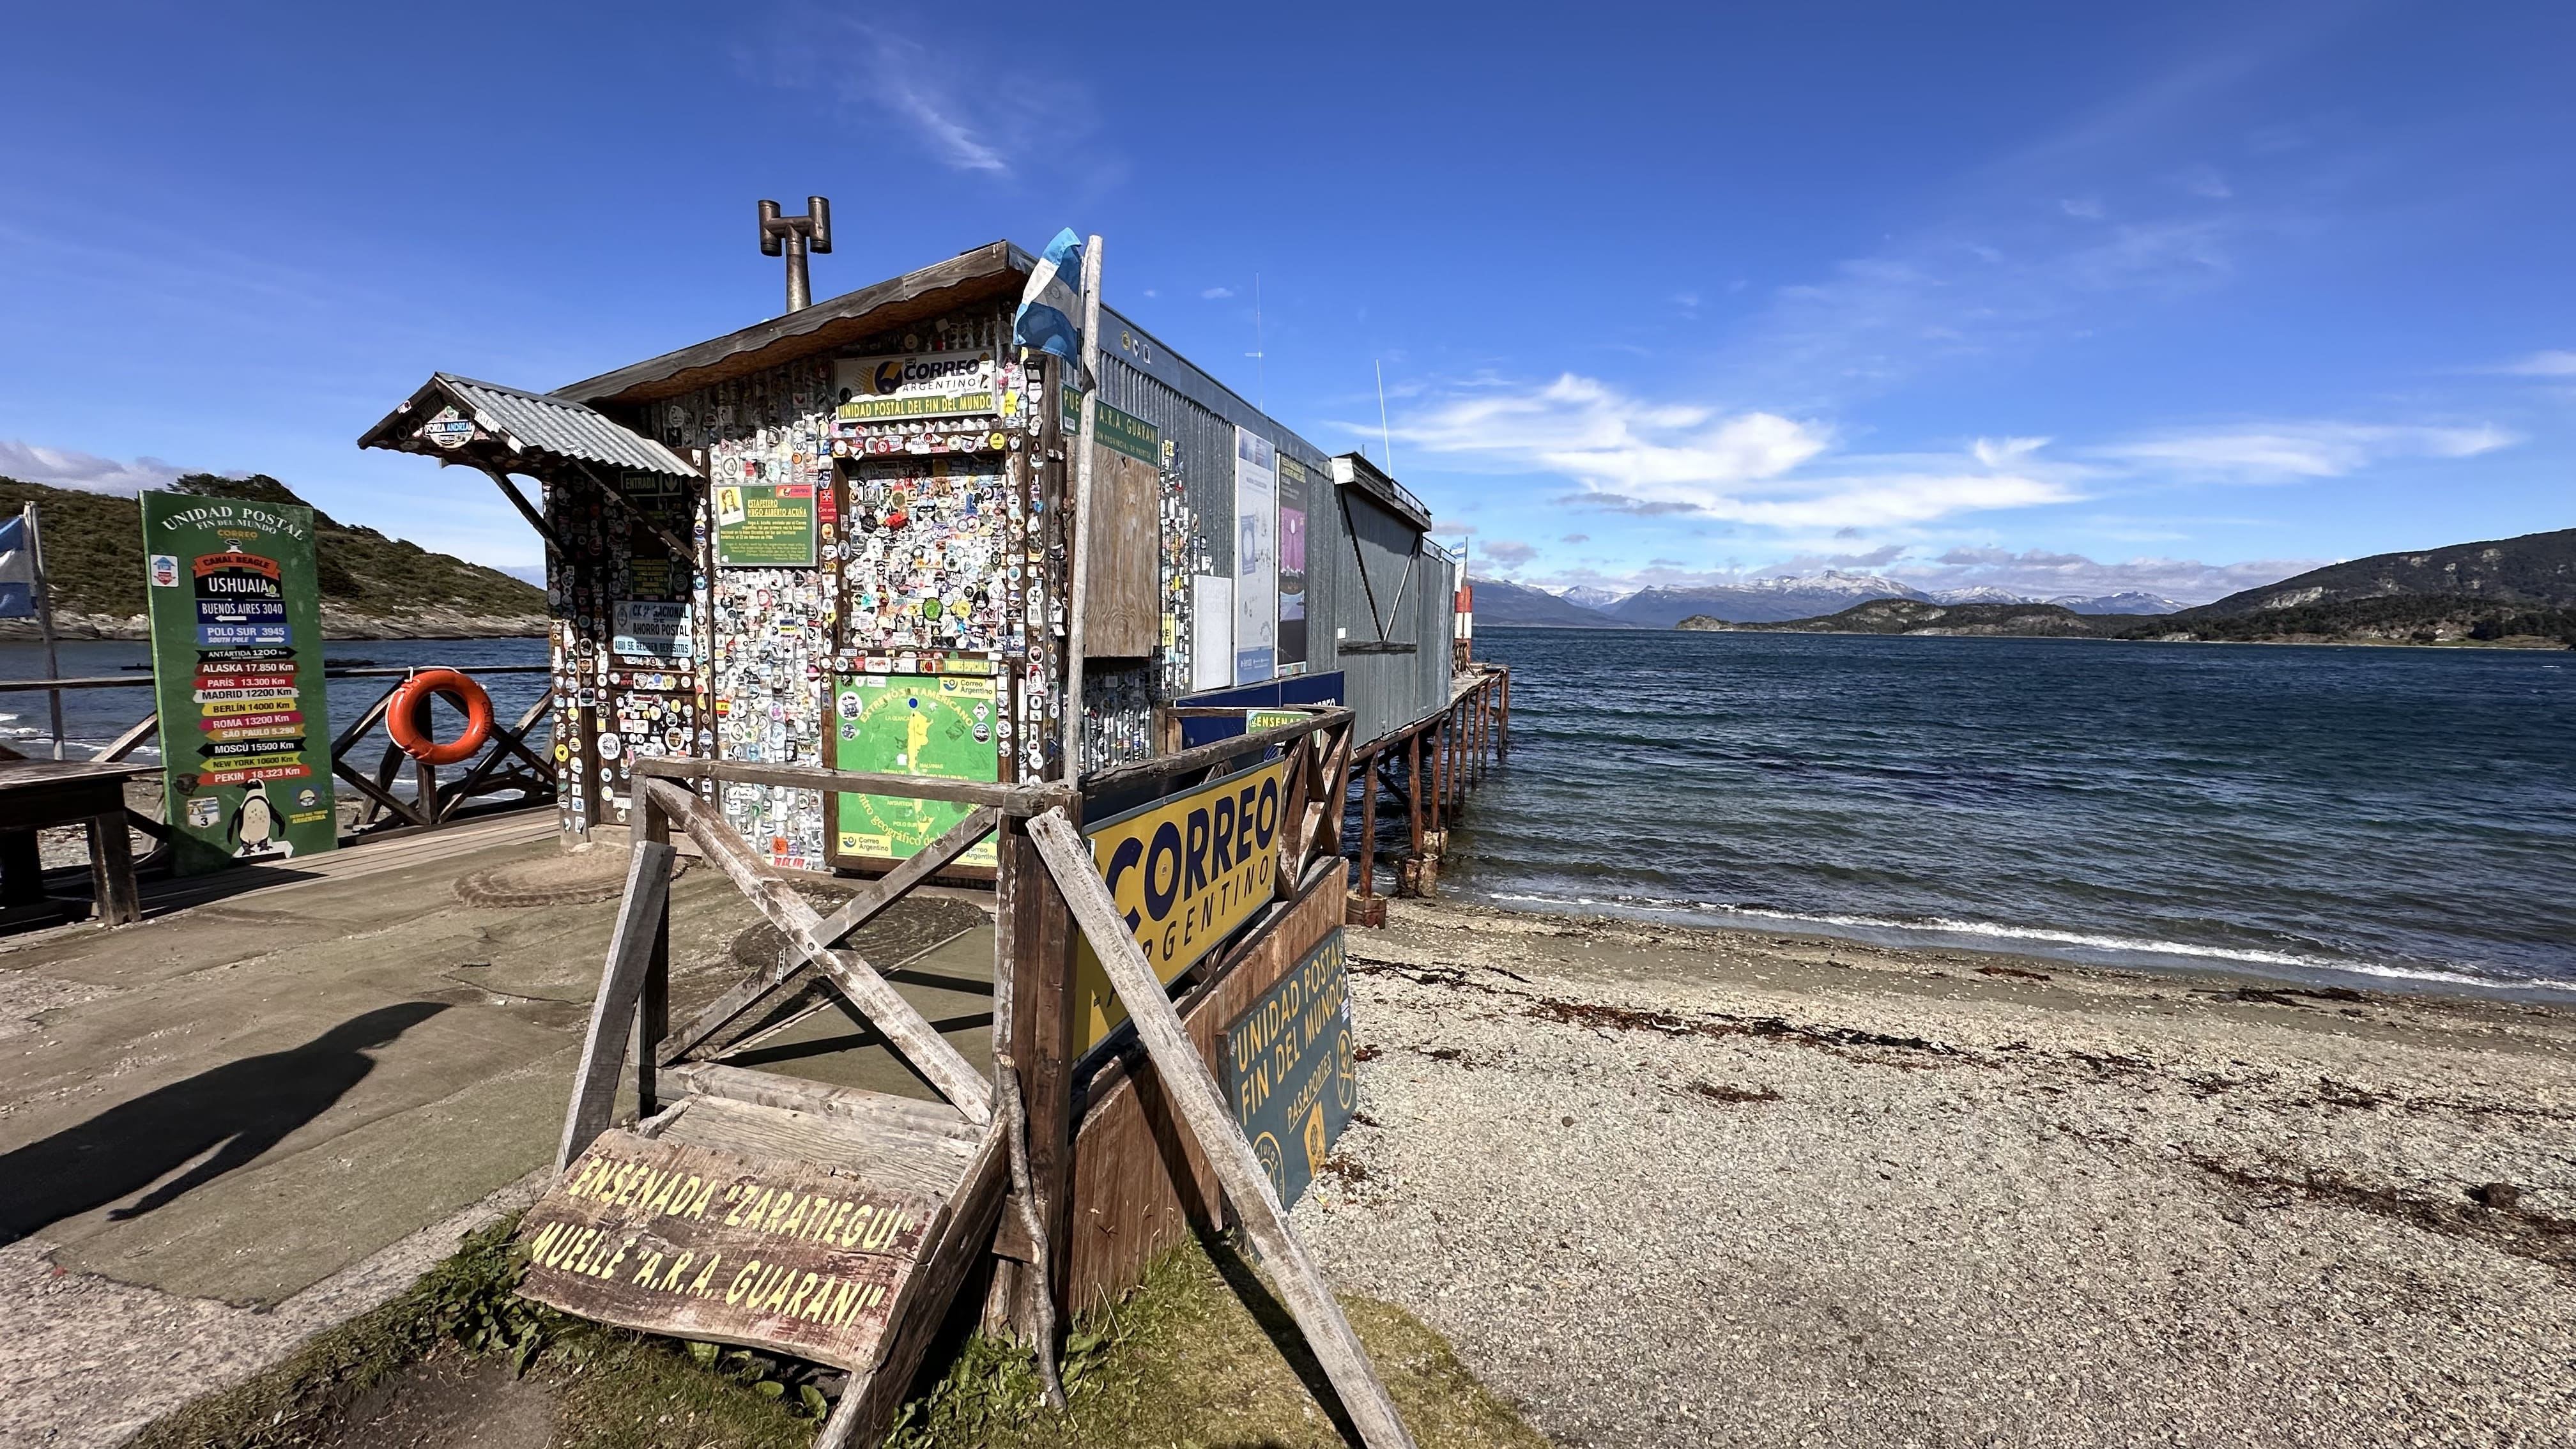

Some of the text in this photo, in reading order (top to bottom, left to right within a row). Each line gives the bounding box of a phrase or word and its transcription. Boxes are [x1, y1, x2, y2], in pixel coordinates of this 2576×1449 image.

[904, 358, 979, 380] CORREO
[903, 378, 976, 392] ARGENTINO
[840, 395, 992, 418] UNIDAD POSTAL DEL FIN DEL MUNDO
[1064, 390, 1083, 413] PUE
[425, 424, 446, 433] FORZA
[1099, 406, 1123, 432] A.R.A.
[1126, 418, 1157, 445] GUARANI
[625, 477, 656, 489] ENTRADA
[747, 500, 778, 508] ESTAFETERO
[161, 506, 304, 540] UNIDAD POSTAL
[195, 519, 215, 530] FIN
[237, 519, 277, 535] MUNDO
[217, 529, 257, 538] CORREO
[203, 556, 270, 569] CANAL BEAGLE
[208, 577, 269, 593] USHUAIA
[201, 602, 282, 615] BUENOS AIRES 3040
[207, 627, 285, 636] POLO SUR 3945
[633, 622, 689, 637] AHORRO POSTAL
[627, 641, 634, 650] SE
[208, 649, 251, 657] ANTÁRTIDA
[203, 663, 294, 673] ALASKA 17.850 Km
[207, 678, 234, 687] PARÍS
[241, 678, 270, 686] 13.300
[202, 690, 243, 700] MADRID
[245, 689, 274, 697] 12200
[960, 687, 993, 695] Argentino
[213, 701, 290, 714] BERLÍN 14000 Km
[859, 688, 898, 723] EXTREMO
[920, 688, 974, 726] AMERICANO
[213, 714, 289, 728] ROMA 13200 Km
[241, 728, 270, 737] PAULO
[215, 741, 295, 754] MOSCÚ 15500 Km
[234, 758, 255, 767] YORK
[281, 755, 293, 763] Km
[215, 767, 300, 783] PEKIN 18.323 Km
[201, 817, 208, 826] 3
[871, 815, 921, 846] geográfico
[1105, 776, 1278, 933] CORREO
[1142, 855, 1269, 962] RGENTINO
[1236, 937, 1343, 1073] UNIDAD POSTAL
[1241, 1057, 1269, 1126] FIN
[1276, 1026, 1300, 1085] DEL
[1305, 973, 1344, 1050] MUNDO
[1287, 1050, 1333, 1128] PASAPORTES
[567, 1158, 717, 1224] ENSENADA
[531, 1220, 886, 1331] MUELLE "A.R.A. GUARANI"
